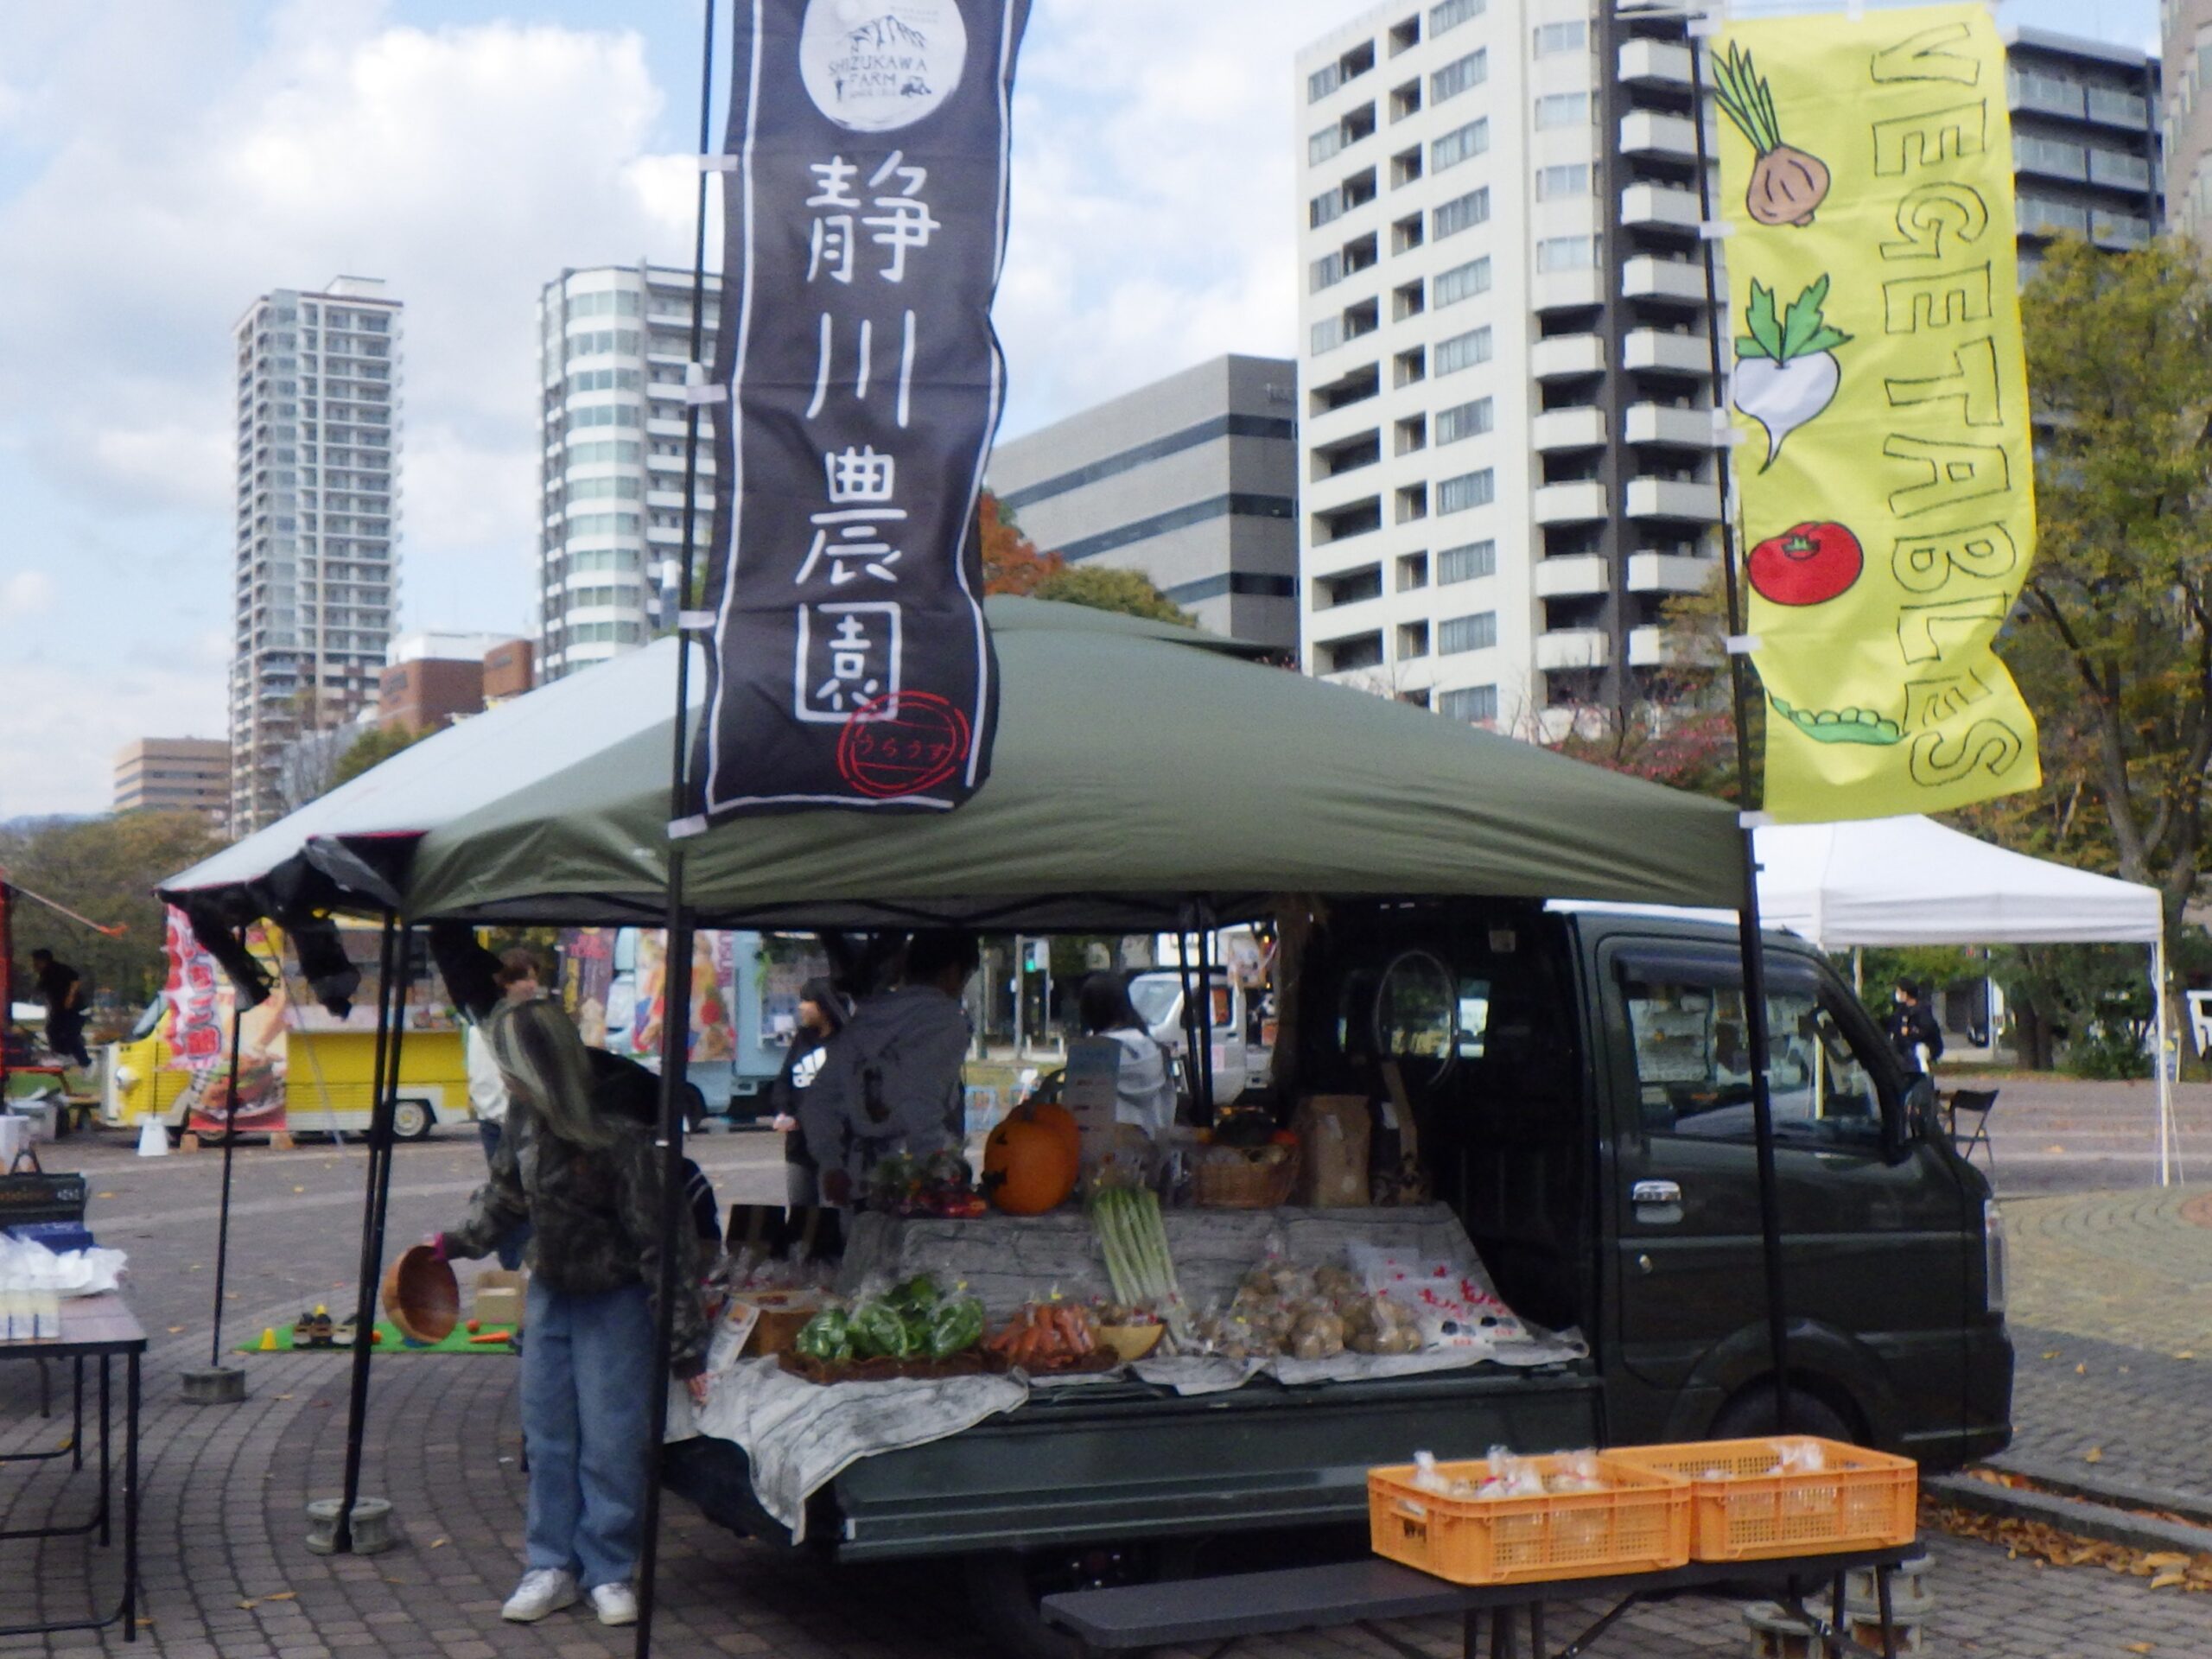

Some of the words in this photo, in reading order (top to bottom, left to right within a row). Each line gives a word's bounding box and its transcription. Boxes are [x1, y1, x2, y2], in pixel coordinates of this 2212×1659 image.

[828, 54, 927, 76] SHIZUKAWA
[849, 72, 897, 86] FARM
[795, 149, 942, 722] 静川農園
[1870, 22, 2022, 786] VEGETABLES
